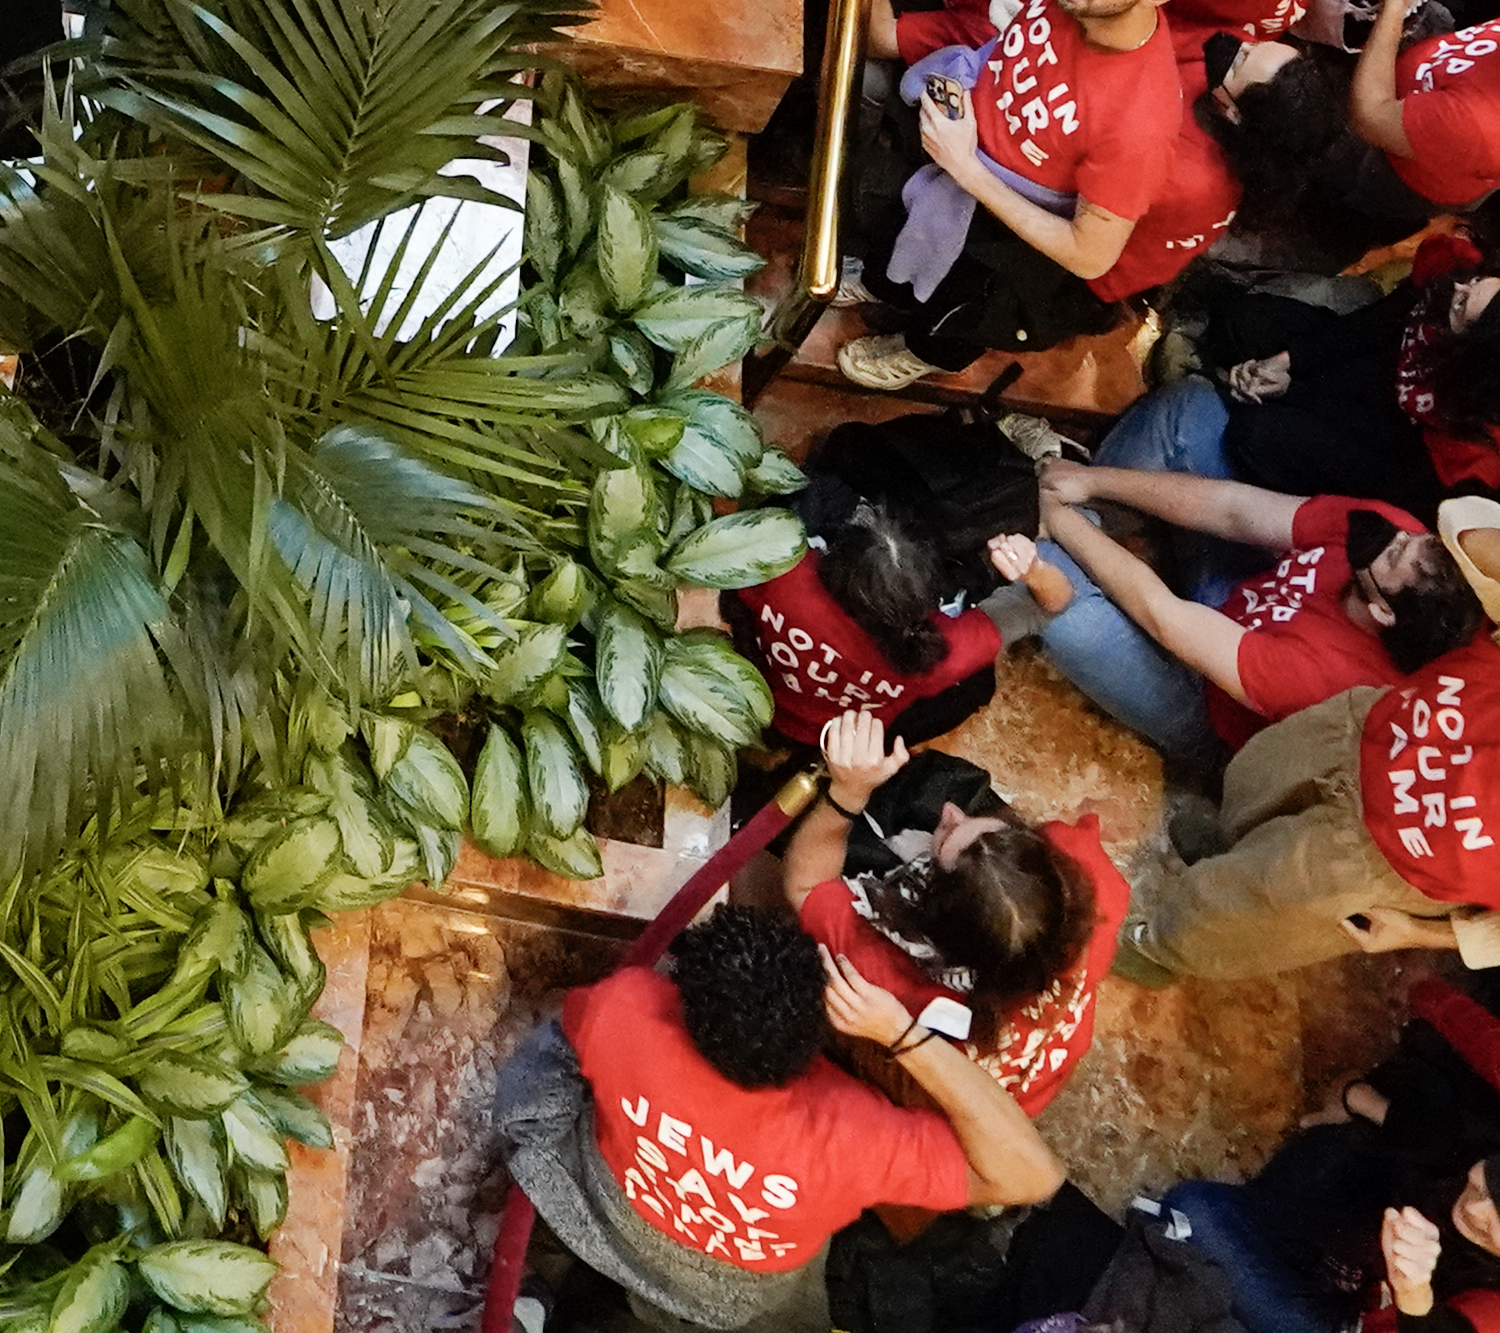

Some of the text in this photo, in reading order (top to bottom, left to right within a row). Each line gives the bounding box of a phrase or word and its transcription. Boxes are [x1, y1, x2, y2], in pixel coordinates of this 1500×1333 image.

[1003, 25, 1049, 135] OUR
[1048, 82, 1081, 136] IN
[761, 603, 906, 701] NOT IN
[773, 640, 874, 706] OUR
[1409, 697, 1449, 831] OUR
[1436, 674, 1496, 854] NOT IN
[621, 1095, 799, 1210] JEWS
